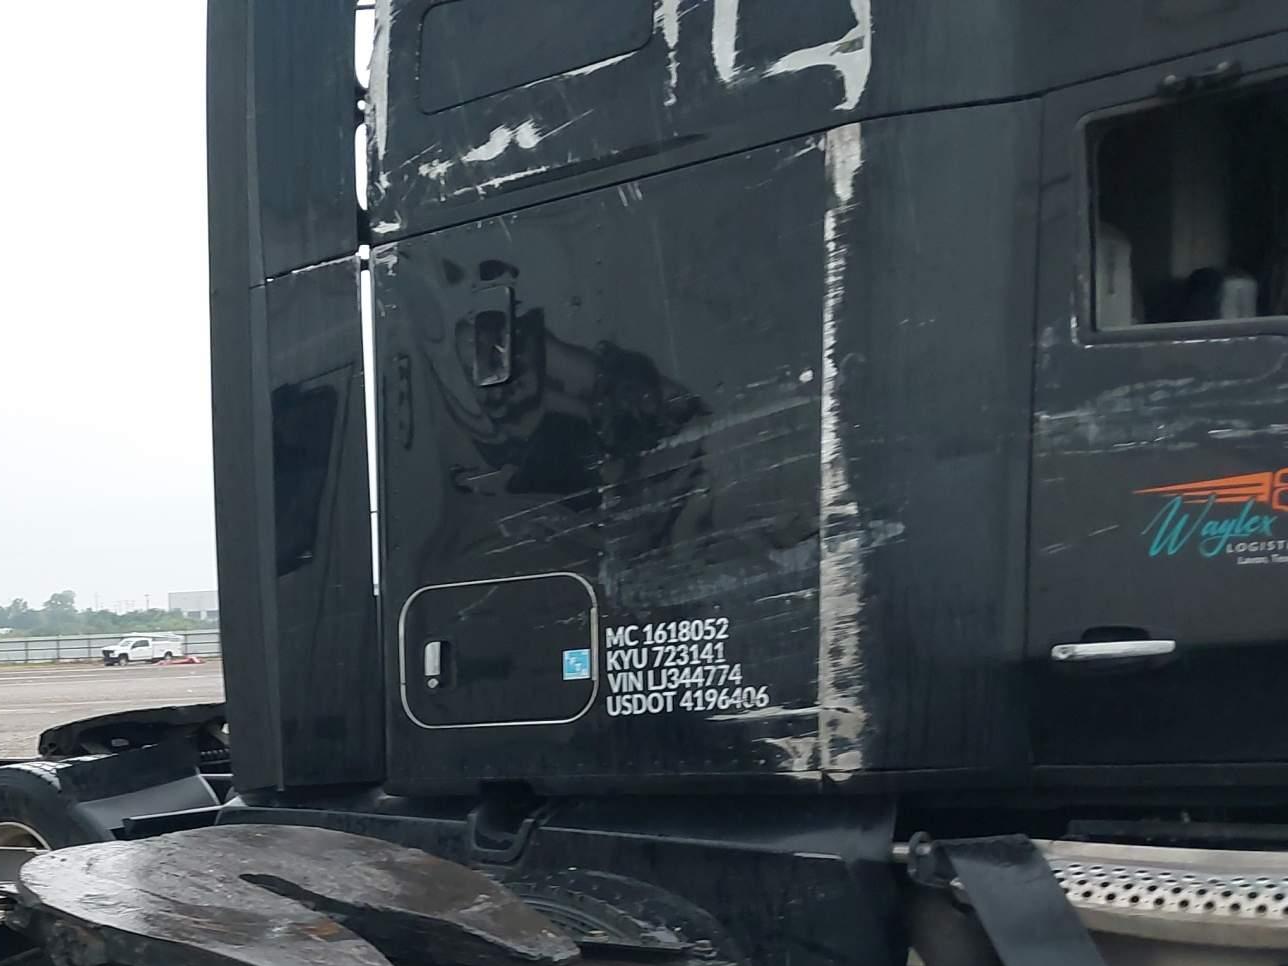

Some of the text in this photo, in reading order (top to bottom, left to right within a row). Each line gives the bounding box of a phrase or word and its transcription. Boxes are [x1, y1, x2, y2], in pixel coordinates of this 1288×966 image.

[605, 617, 729, 648] MC 1618052
[606, 642, 726, 671] KYU 723141
[607, 663, 743, 693] VIN LJ344774
[606, 685, 770, 716] USDOT 4196406
